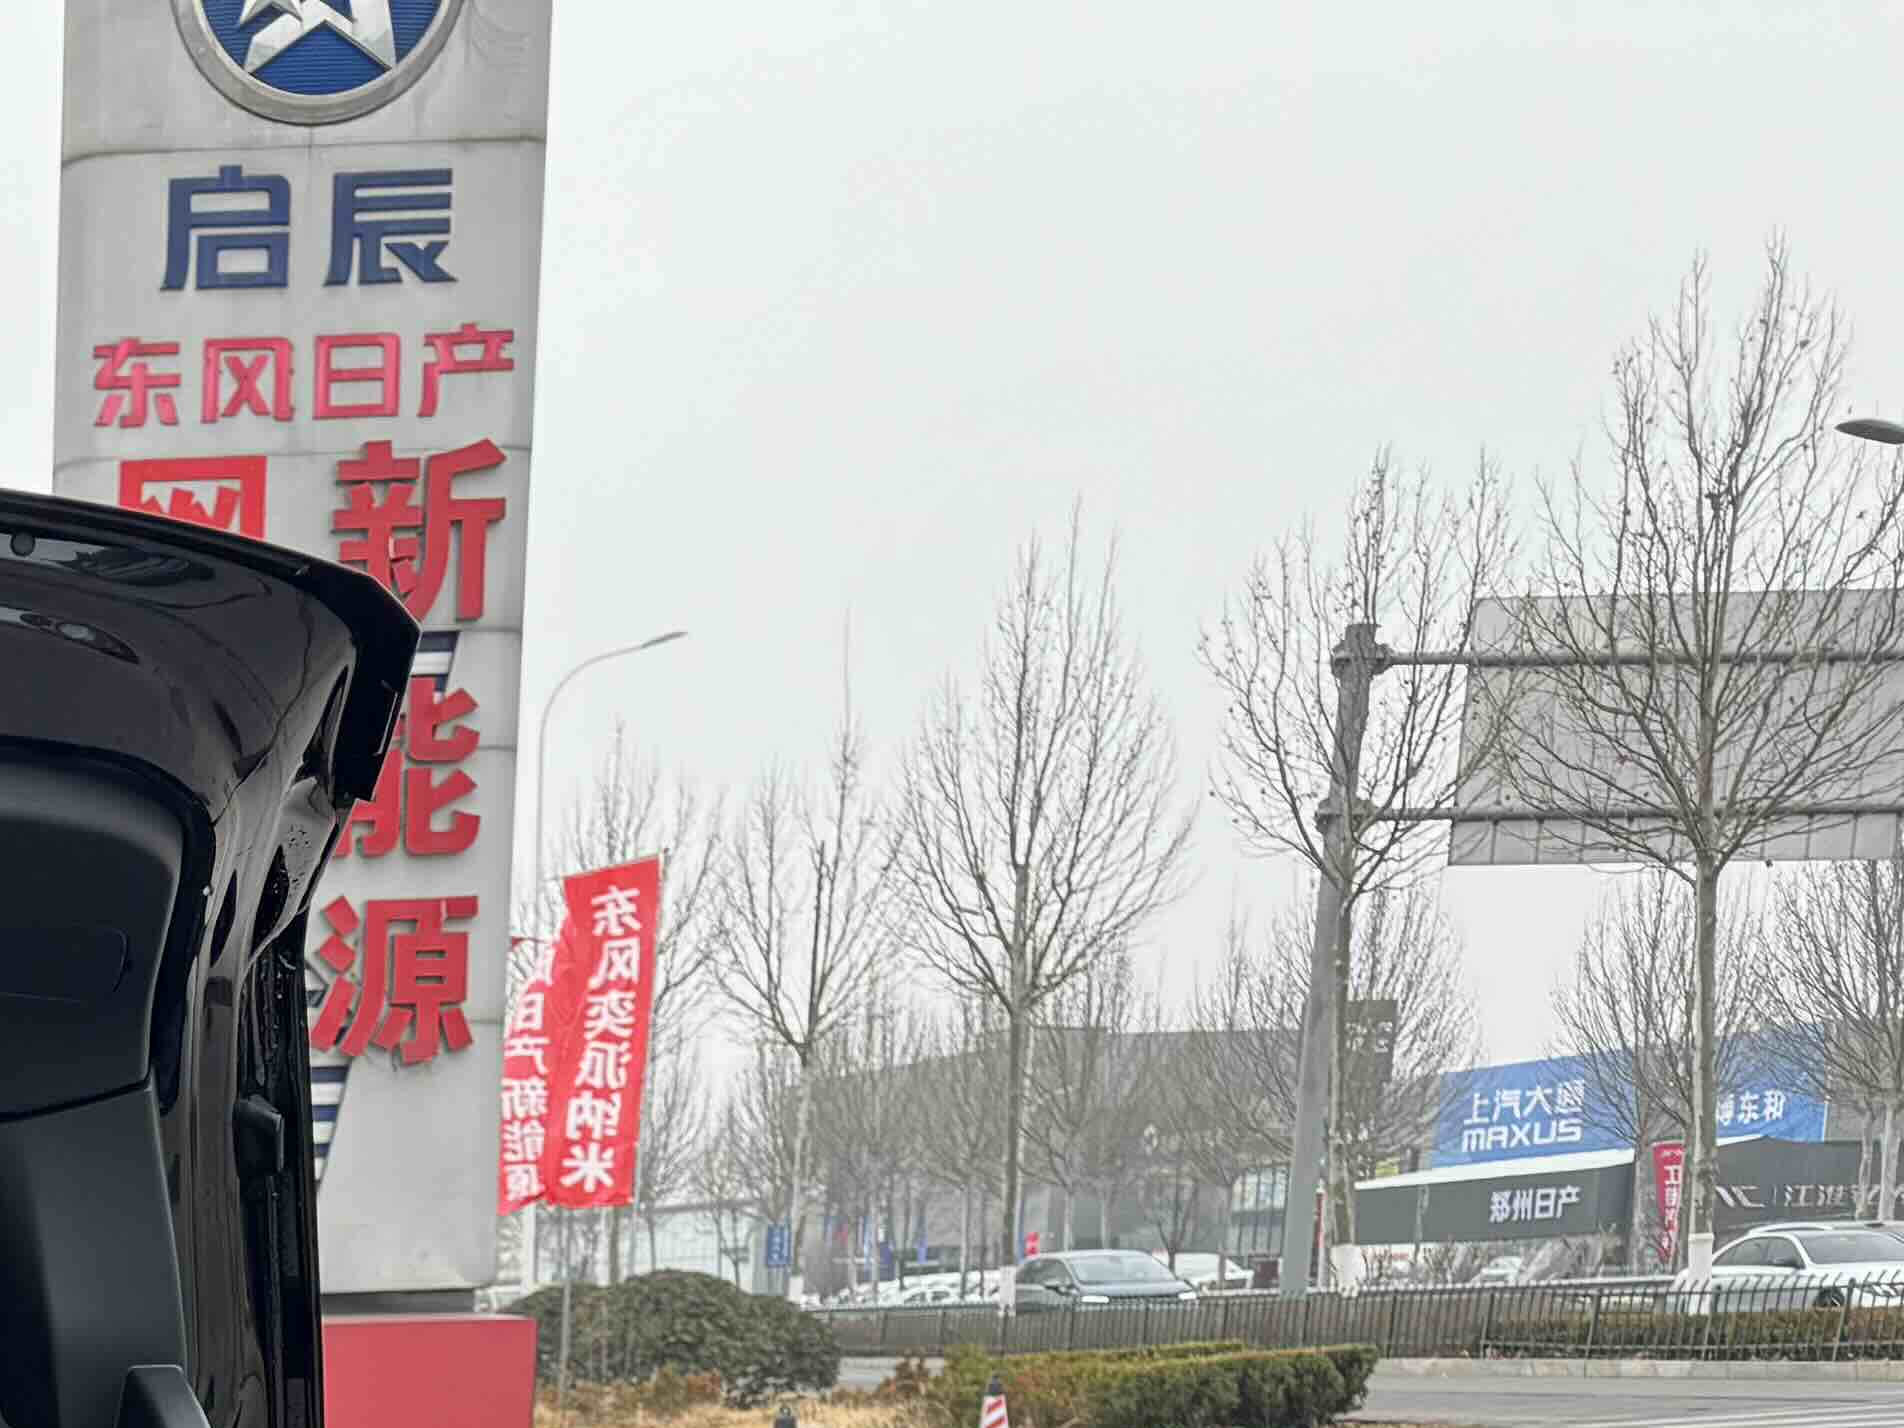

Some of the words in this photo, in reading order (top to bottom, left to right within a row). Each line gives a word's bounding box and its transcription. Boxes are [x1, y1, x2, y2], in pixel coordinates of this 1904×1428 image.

[159, 164, 458, 291] 启辰
[94, 323, 514, 428] 东风日产
[310, 439, 507, 1064] 新能源
[1462, 1118, 1584, 1152] MAXUS
[1490, 1185, 1580, 1222] 郑州日产
